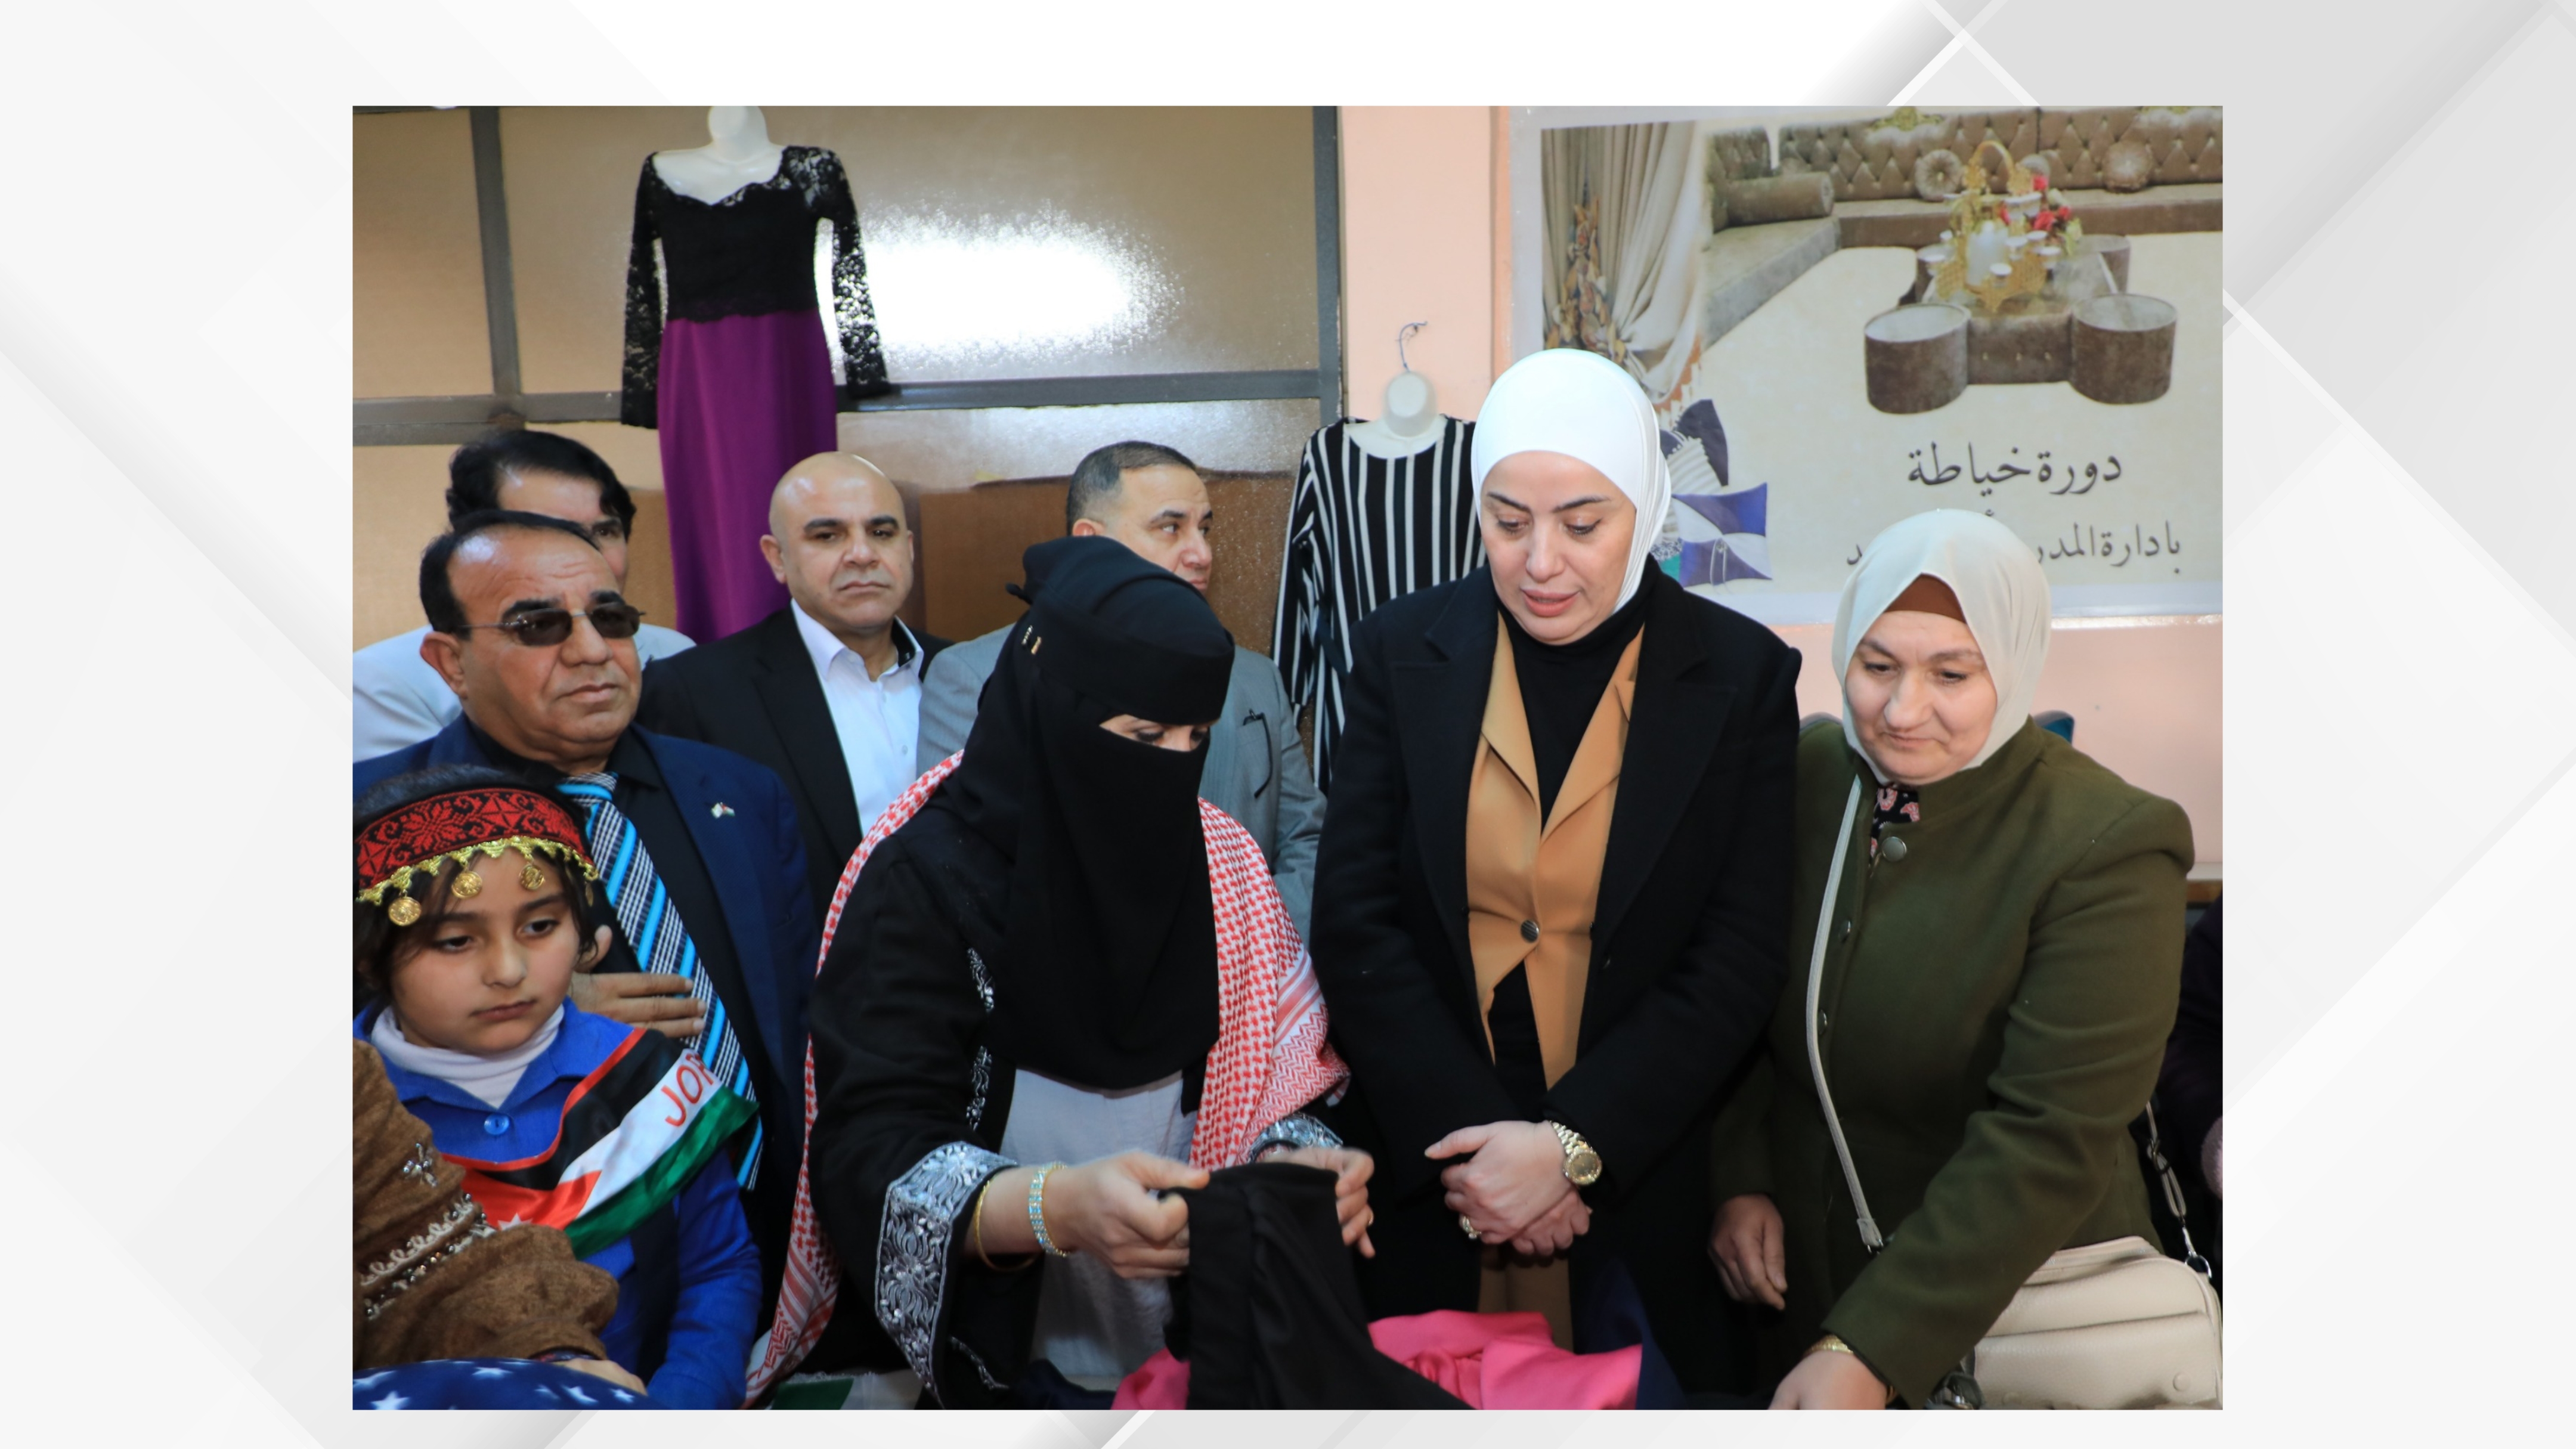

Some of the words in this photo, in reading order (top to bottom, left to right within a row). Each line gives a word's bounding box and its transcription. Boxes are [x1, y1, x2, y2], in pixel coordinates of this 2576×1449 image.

[1908, 441, 2032, 497] خياطة
[2037, 451, 2122, 495] دورة
[2037, 522, 2095, 564] المدر
